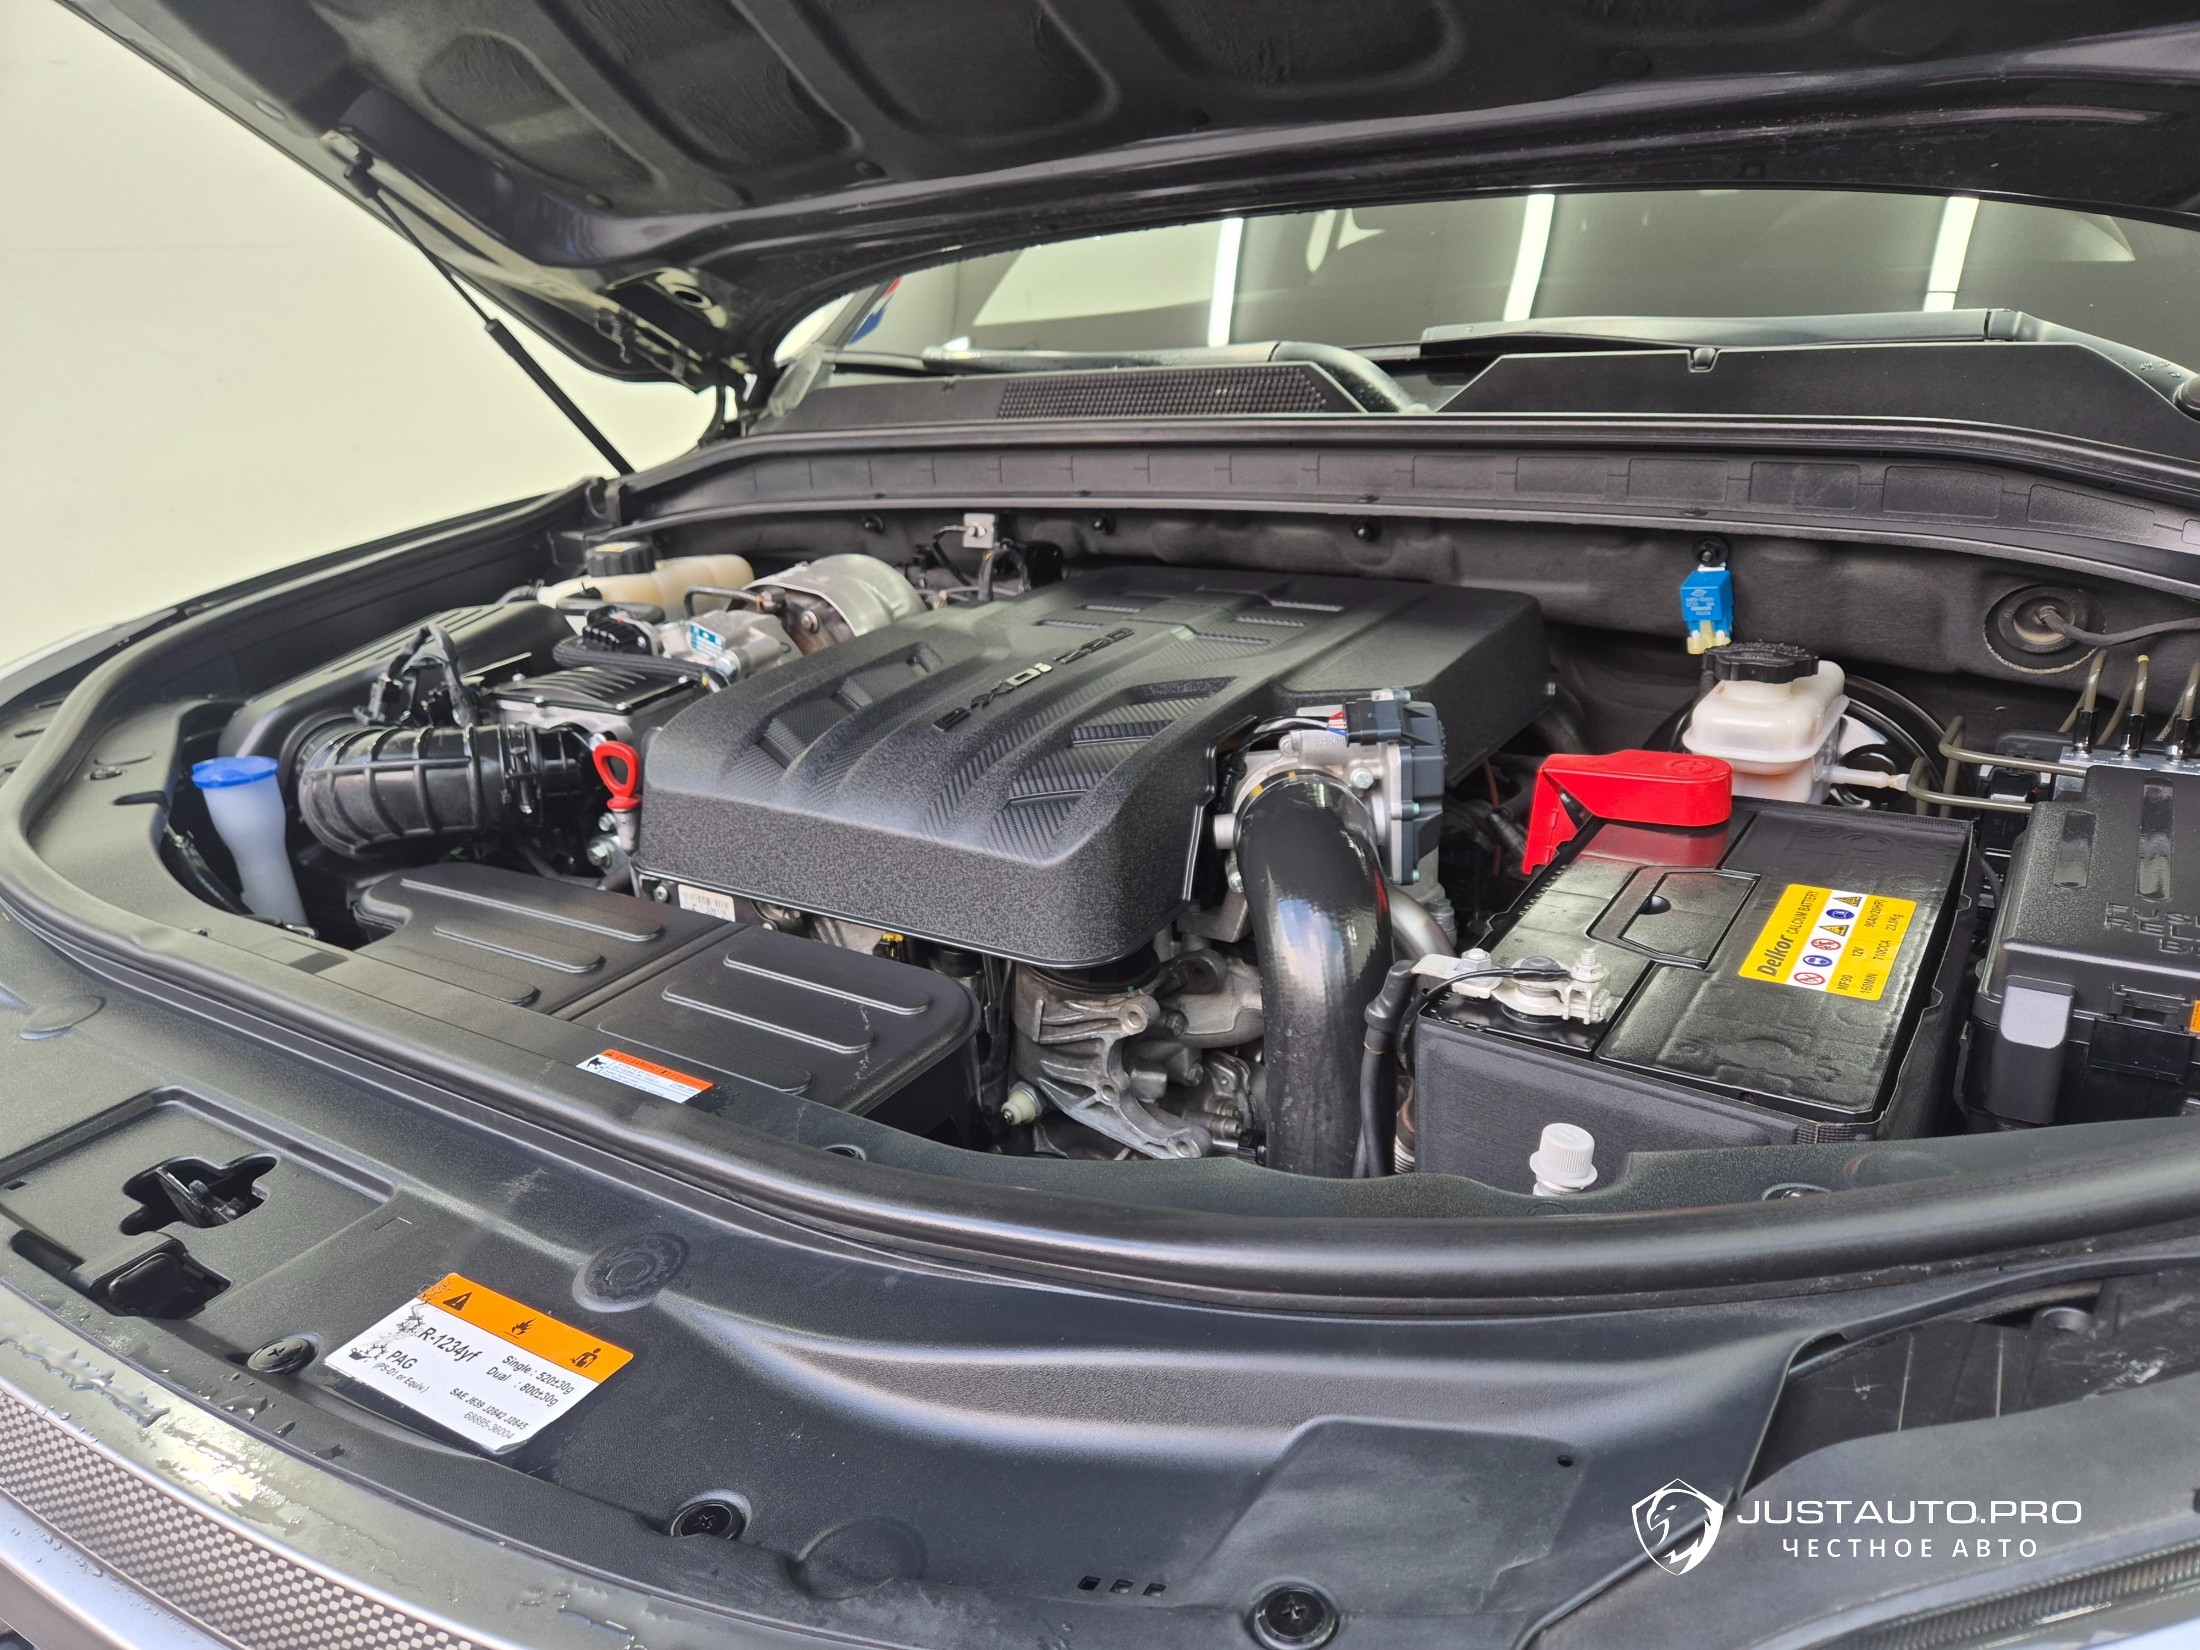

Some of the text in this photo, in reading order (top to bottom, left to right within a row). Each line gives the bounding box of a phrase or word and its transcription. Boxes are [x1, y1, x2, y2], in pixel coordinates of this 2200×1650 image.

[1756, 889, 1820, 977] Delkor CALCIUM BATTERY
[1873, 939, 1892, 961] 710CCA
[1836, 974, 1854, 991] MF90
[1850, 946, 1865, 957] 12V
[385, 1349, 418, 1369] PAG
[417, 1326, 483, 1363] R-1234yf
[486, 1366, 512, 1382] Dual
[519, 1382, 559, 1407] 800±30g
[502, 1355, 532, 1375] Single
[535, 1371, 575, 1396] 520±30g
[449, 1387, 469, 1400] SAE
[465, 1395, 486, 1409] J639
[482, 1405, 507, 1420] J2842
[463, 1410, 516, 1440] 68895-36004
